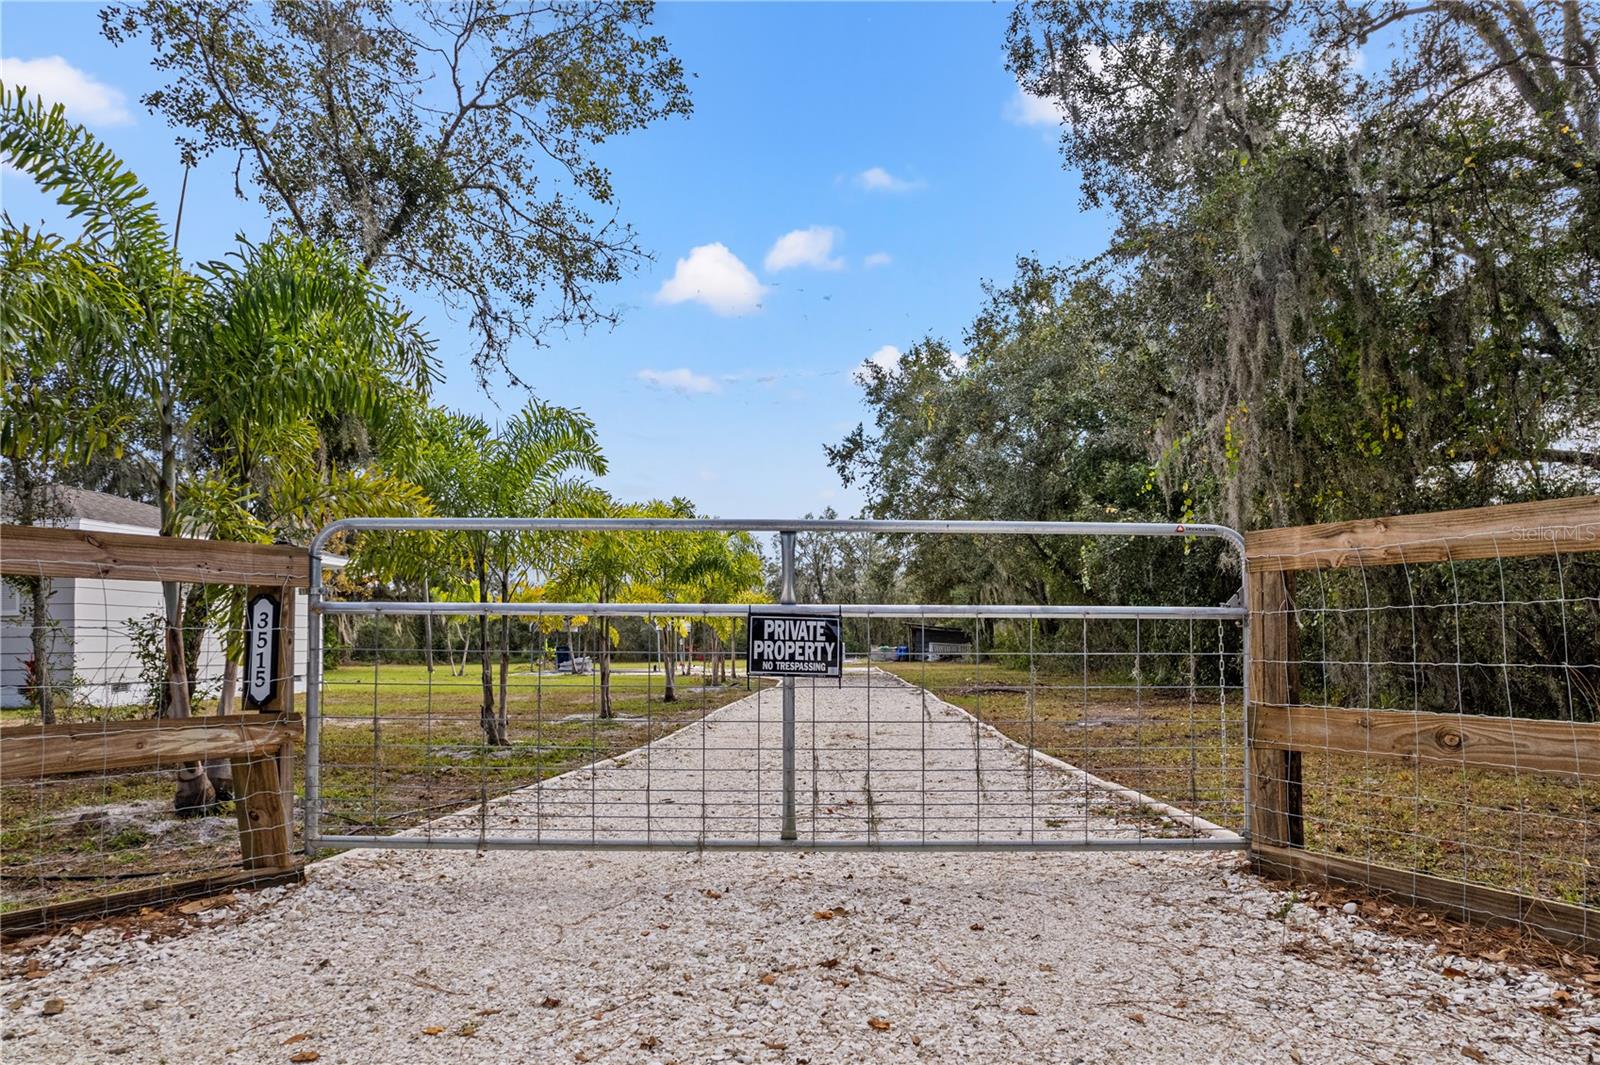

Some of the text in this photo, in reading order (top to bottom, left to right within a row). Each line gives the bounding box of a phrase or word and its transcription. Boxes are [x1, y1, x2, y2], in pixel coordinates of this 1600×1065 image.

[763, 620, 826, 641] PRIVATE
[255, 612, 269, 688] 3515
[753, 640, 836, 662] PROPERTY
[762, 661, 827, 672] NO TRESPASSING
